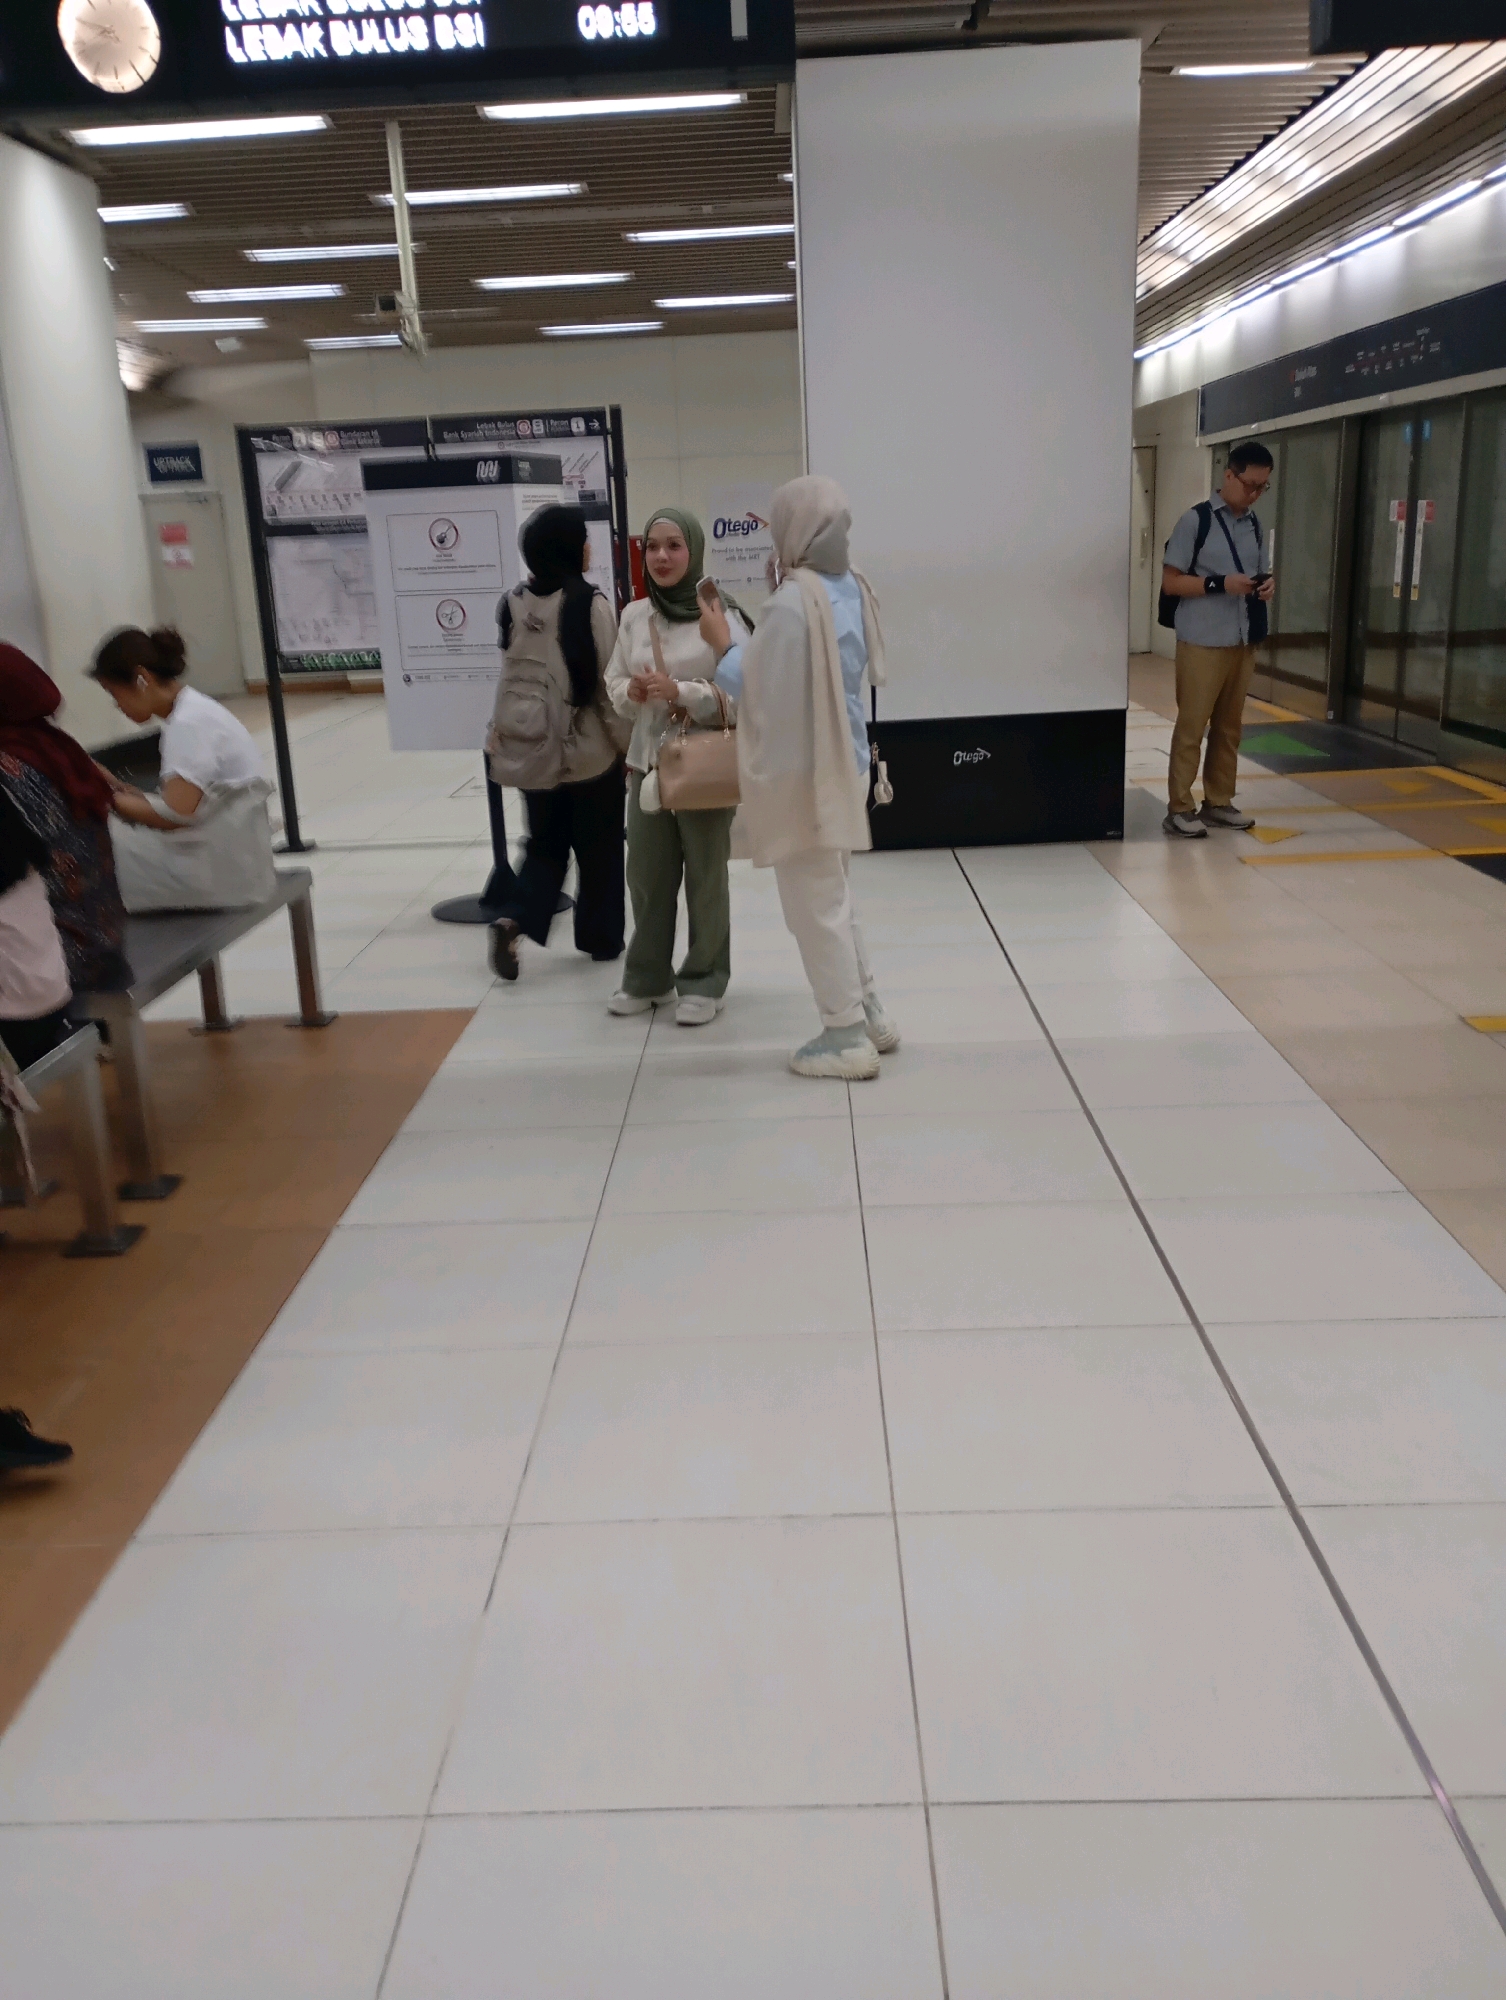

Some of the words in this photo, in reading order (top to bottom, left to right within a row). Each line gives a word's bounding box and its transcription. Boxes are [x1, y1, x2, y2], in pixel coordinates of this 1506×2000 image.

[226, 22, 327, 62] LEBAK
[330, 16, 429, 55] BULUS
[434, 13, 484, 49] BSI
[713, 517, 760, 539] Otego
